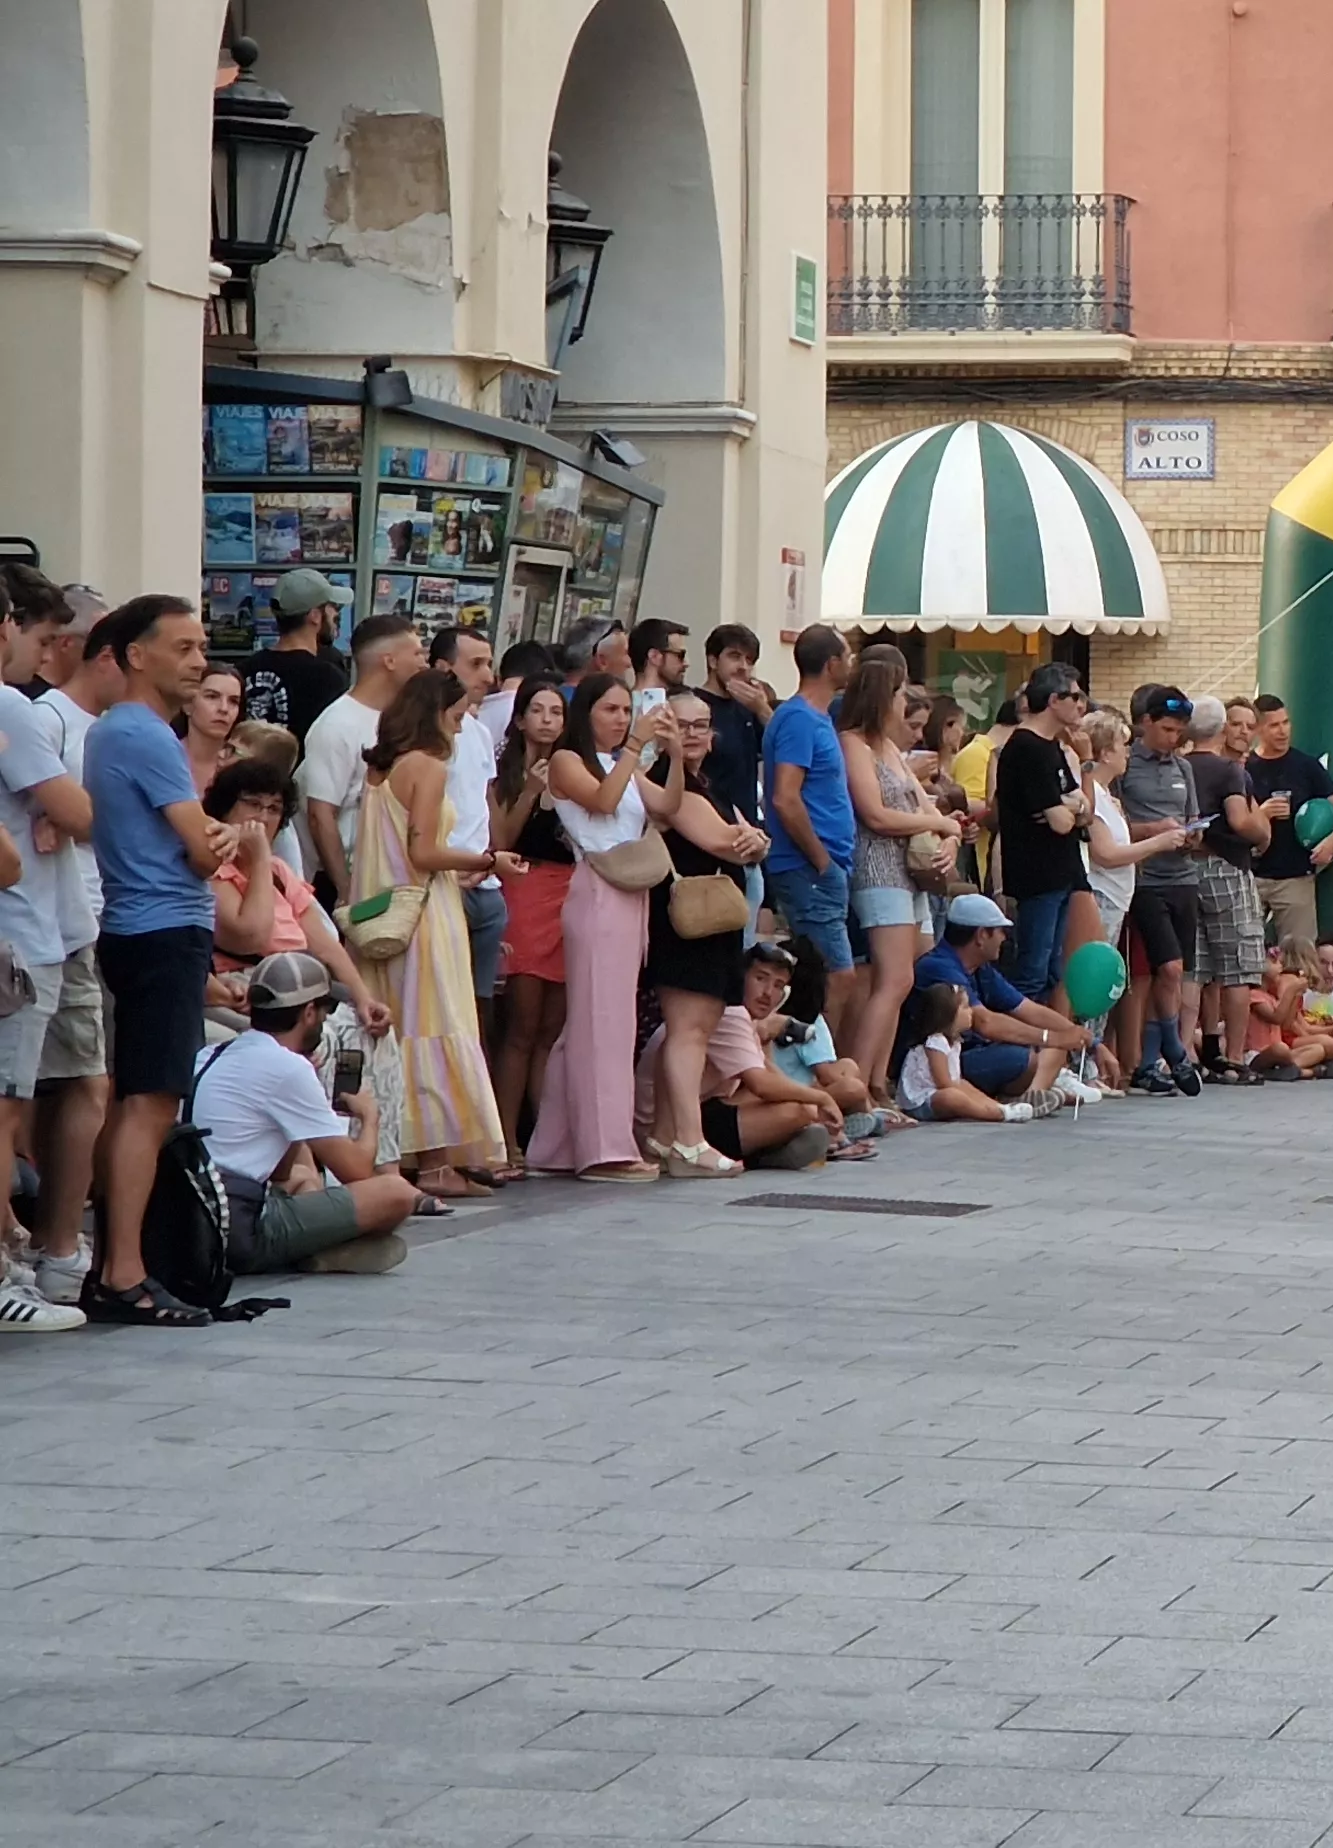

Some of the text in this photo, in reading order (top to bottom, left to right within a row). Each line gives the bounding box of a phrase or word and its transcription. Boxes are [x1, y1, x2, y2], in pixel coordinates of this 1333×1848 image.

[215, 405, 264, 418] VIAJES
[1157, 430, 1199, 442] COSO
[1138, 456, 1202, 470] ALTO
